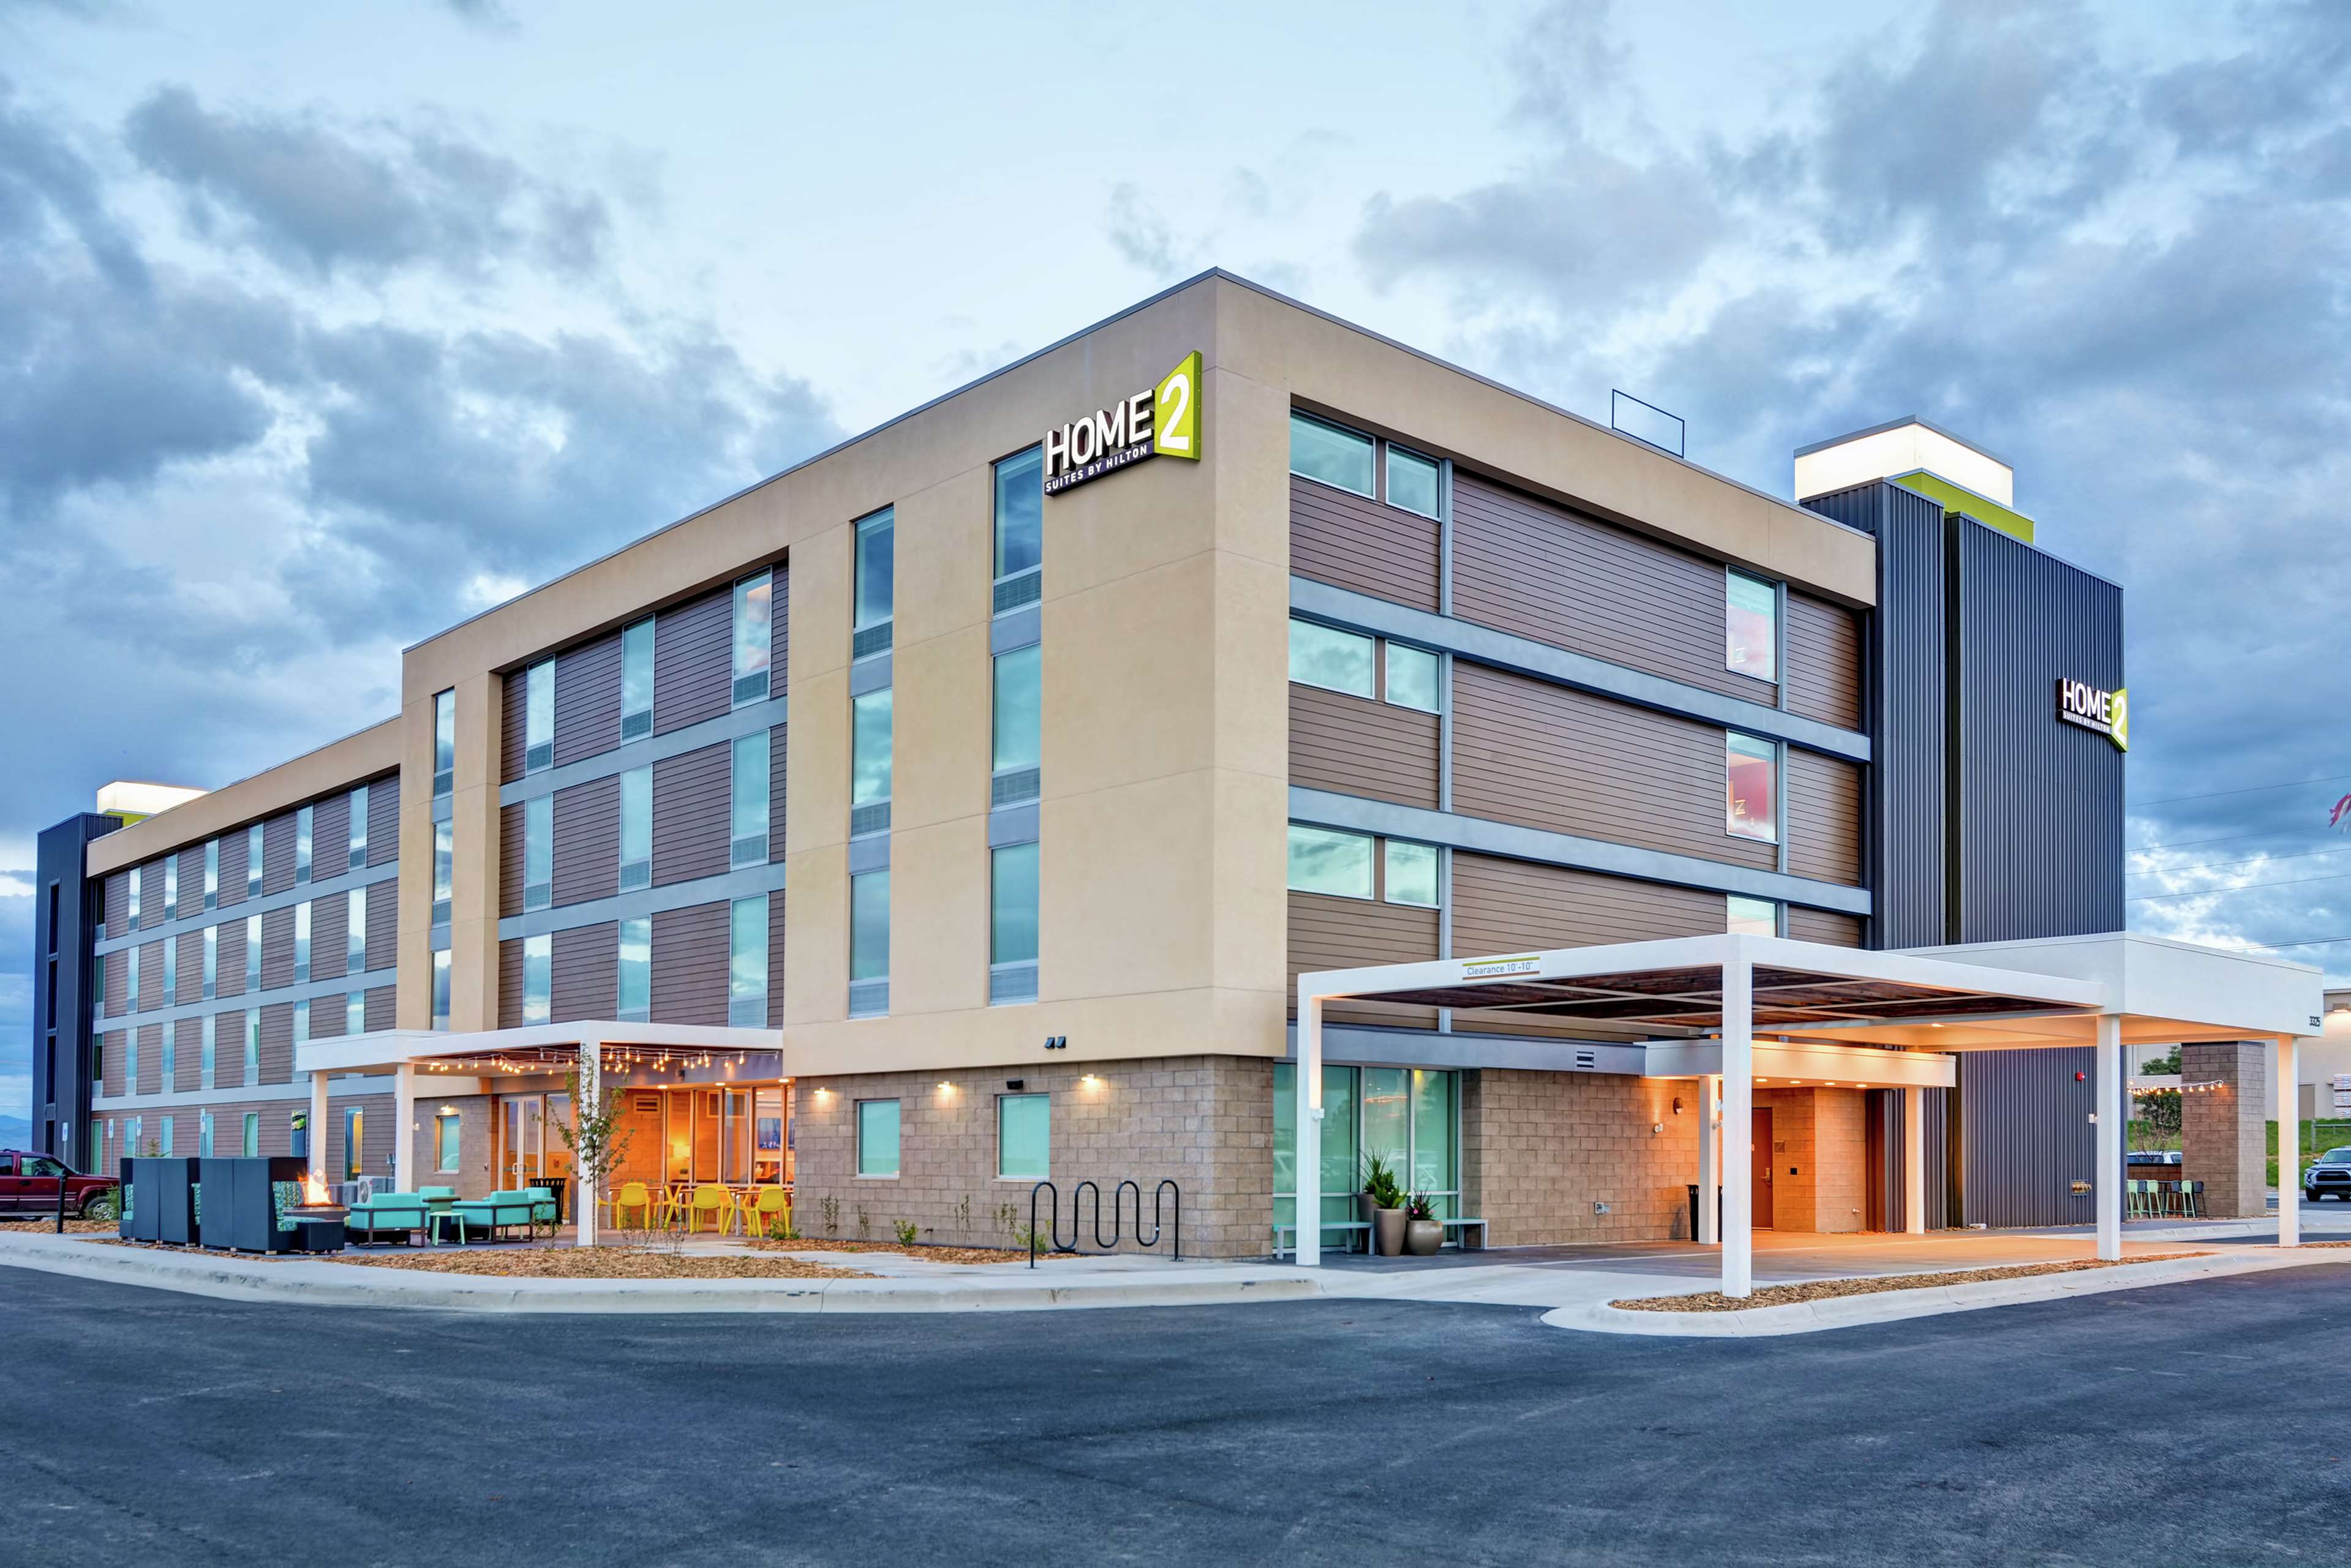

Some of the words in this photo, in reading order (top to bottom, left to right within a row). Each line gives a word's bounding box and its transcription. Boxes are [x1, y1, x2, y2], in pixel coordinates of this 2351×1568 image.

[1047, 388, 1153, 476] HOME
[1159, 373, 1189, 451] 2
[1045, 469, 1083, 492] SUITES
[1088, 462, 1102, 476] BY
[1106, 445, 1148, 468] HILTON
[2063, 677, 2112, 724] HOME
[2113, 696, 2127, 745] 2
[2063, 711, 2082, 723] SUITES
[2091, 721, 2110, 732] HILTON
[1467, 966, 1504, 975] Clearance
